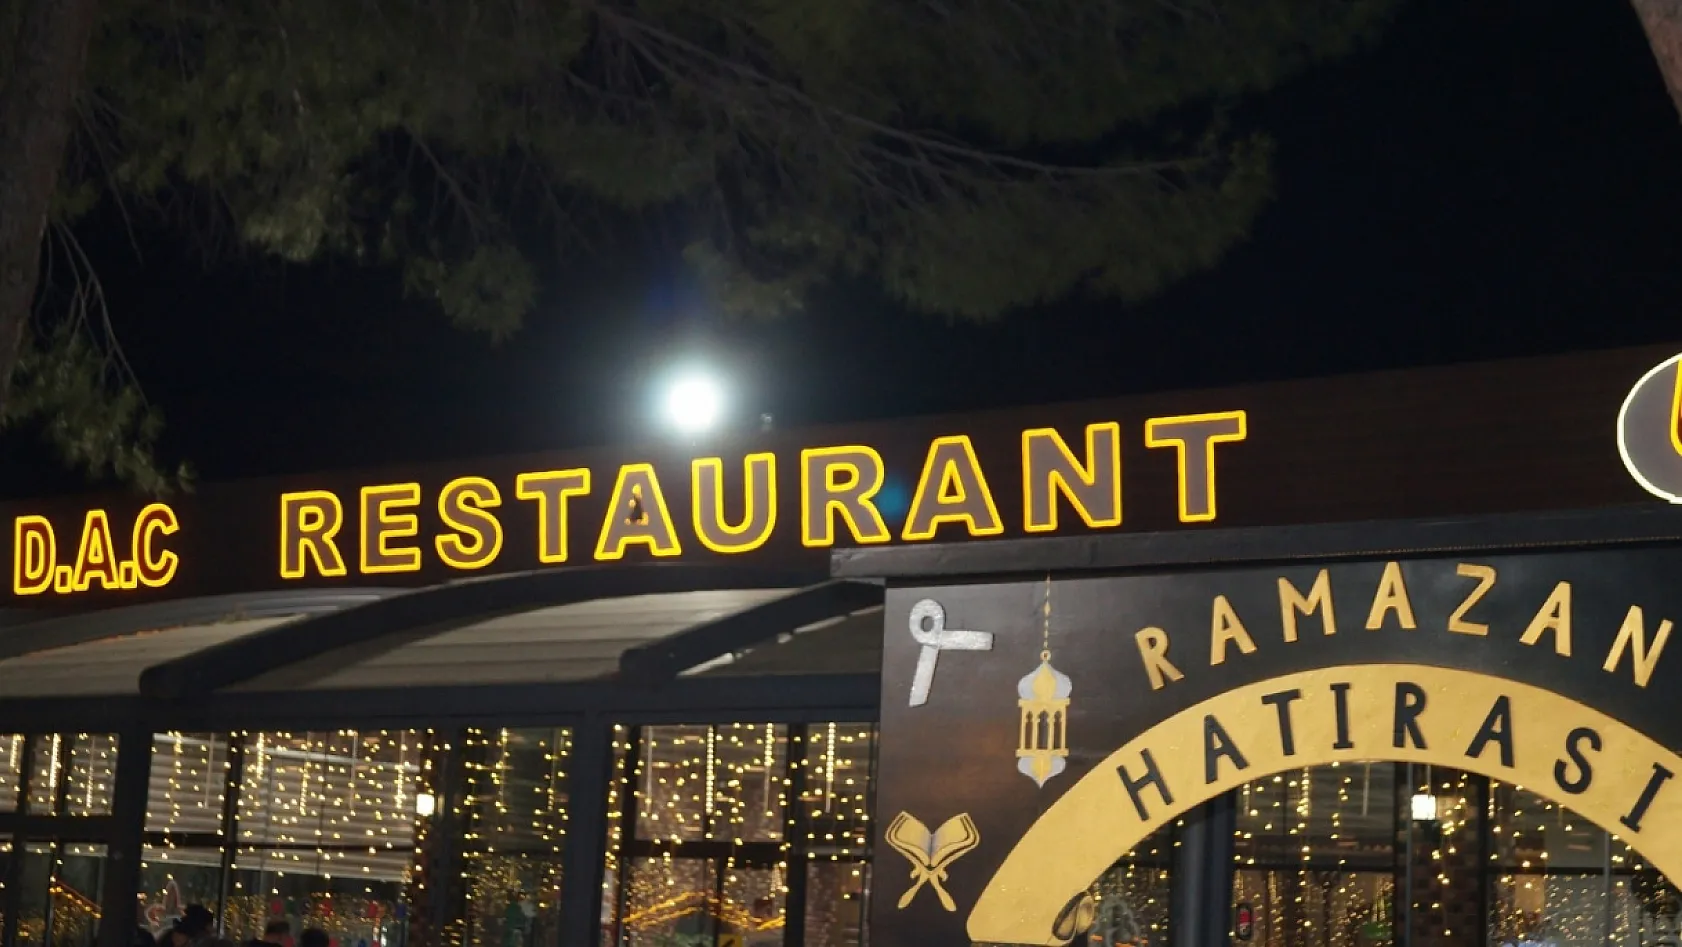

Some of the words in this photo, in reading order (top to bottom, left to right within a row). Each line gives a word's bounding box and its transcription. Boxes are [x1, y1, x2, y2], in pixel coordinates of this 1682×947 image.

[13, 503, 180, 596] D.A.C
[279, 411, 1247, 578] RESTAURANT
[1134, 561, 1673, 689] RAMAZAN
[1117, 682, 1674, 832] HATIRASI
